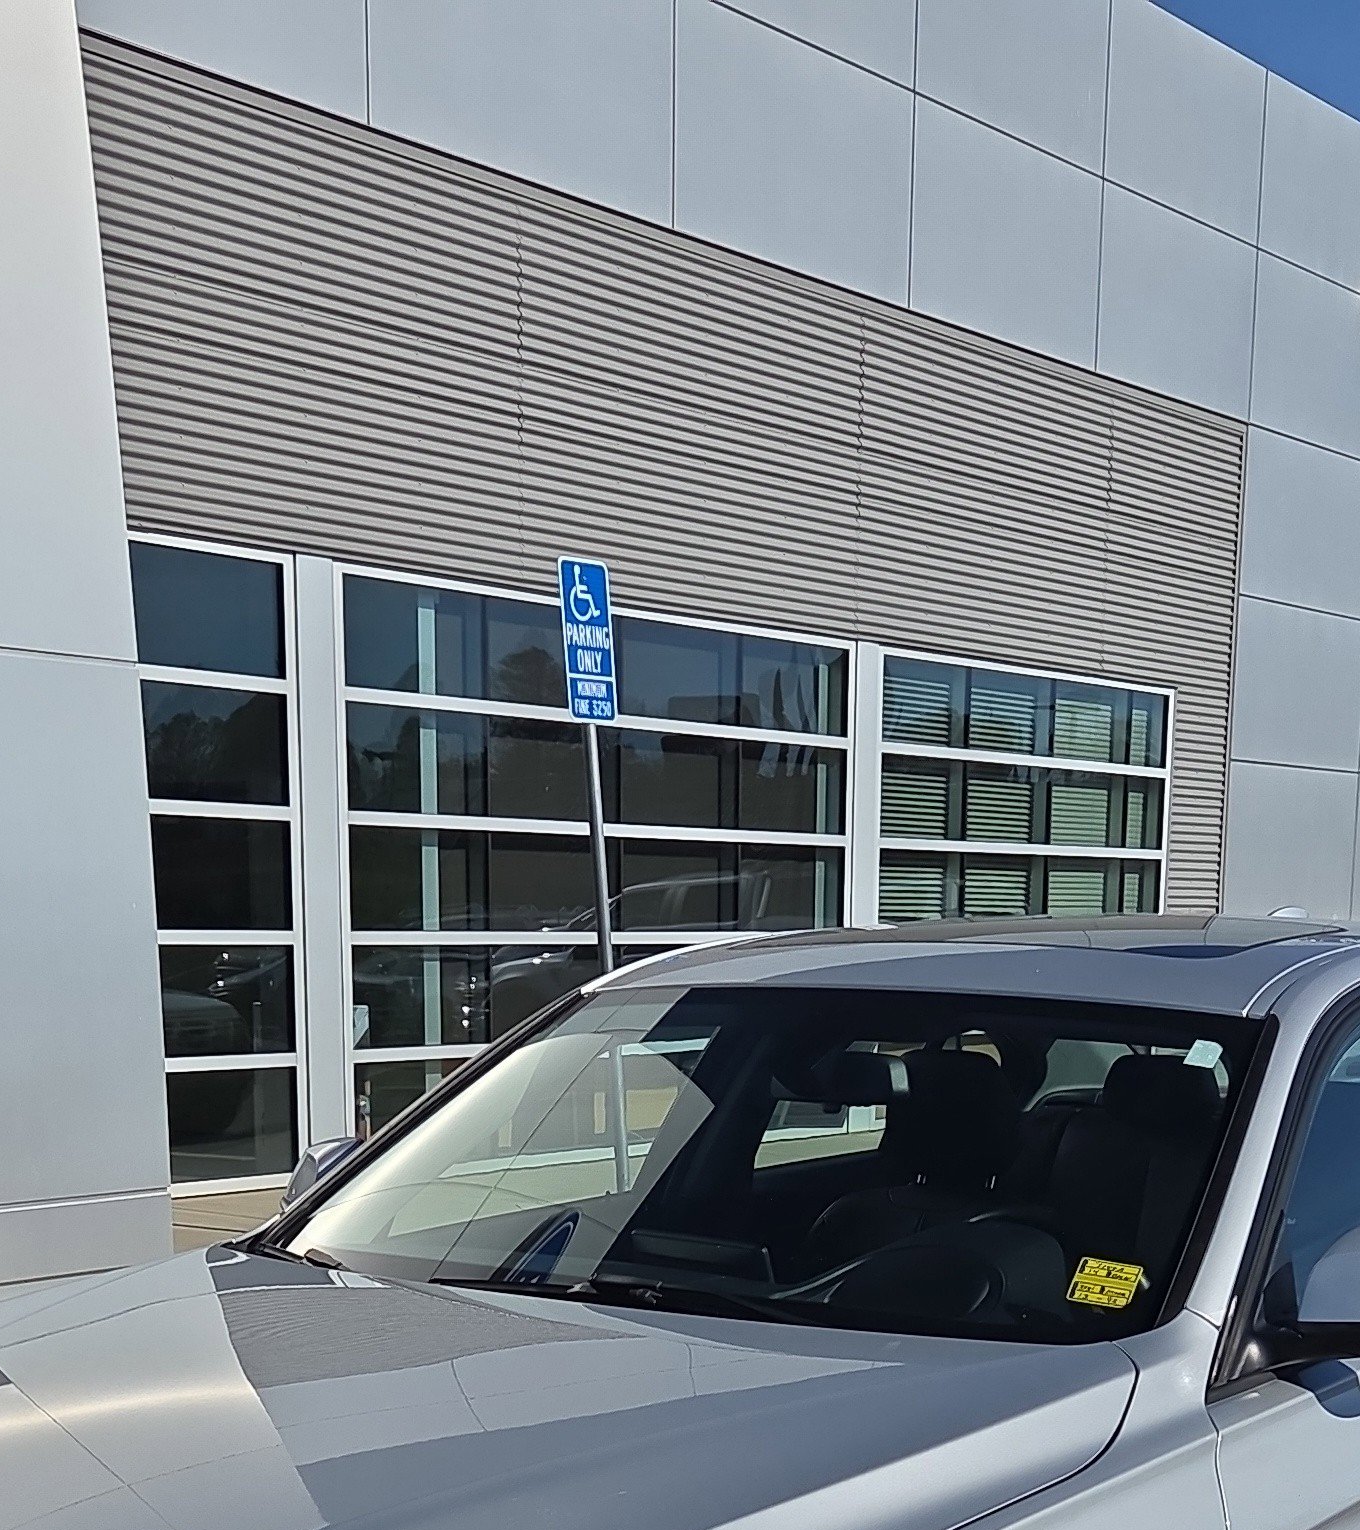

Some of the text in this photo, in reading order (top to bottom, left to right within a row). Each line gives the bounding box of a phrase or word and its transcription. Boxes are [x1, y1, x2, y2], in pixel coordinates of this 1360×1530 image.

[567, 623, 609, 650] PARKING
[577, 649, 603, 674] ONLY
[574, 698, 611, 717] FINE $250
